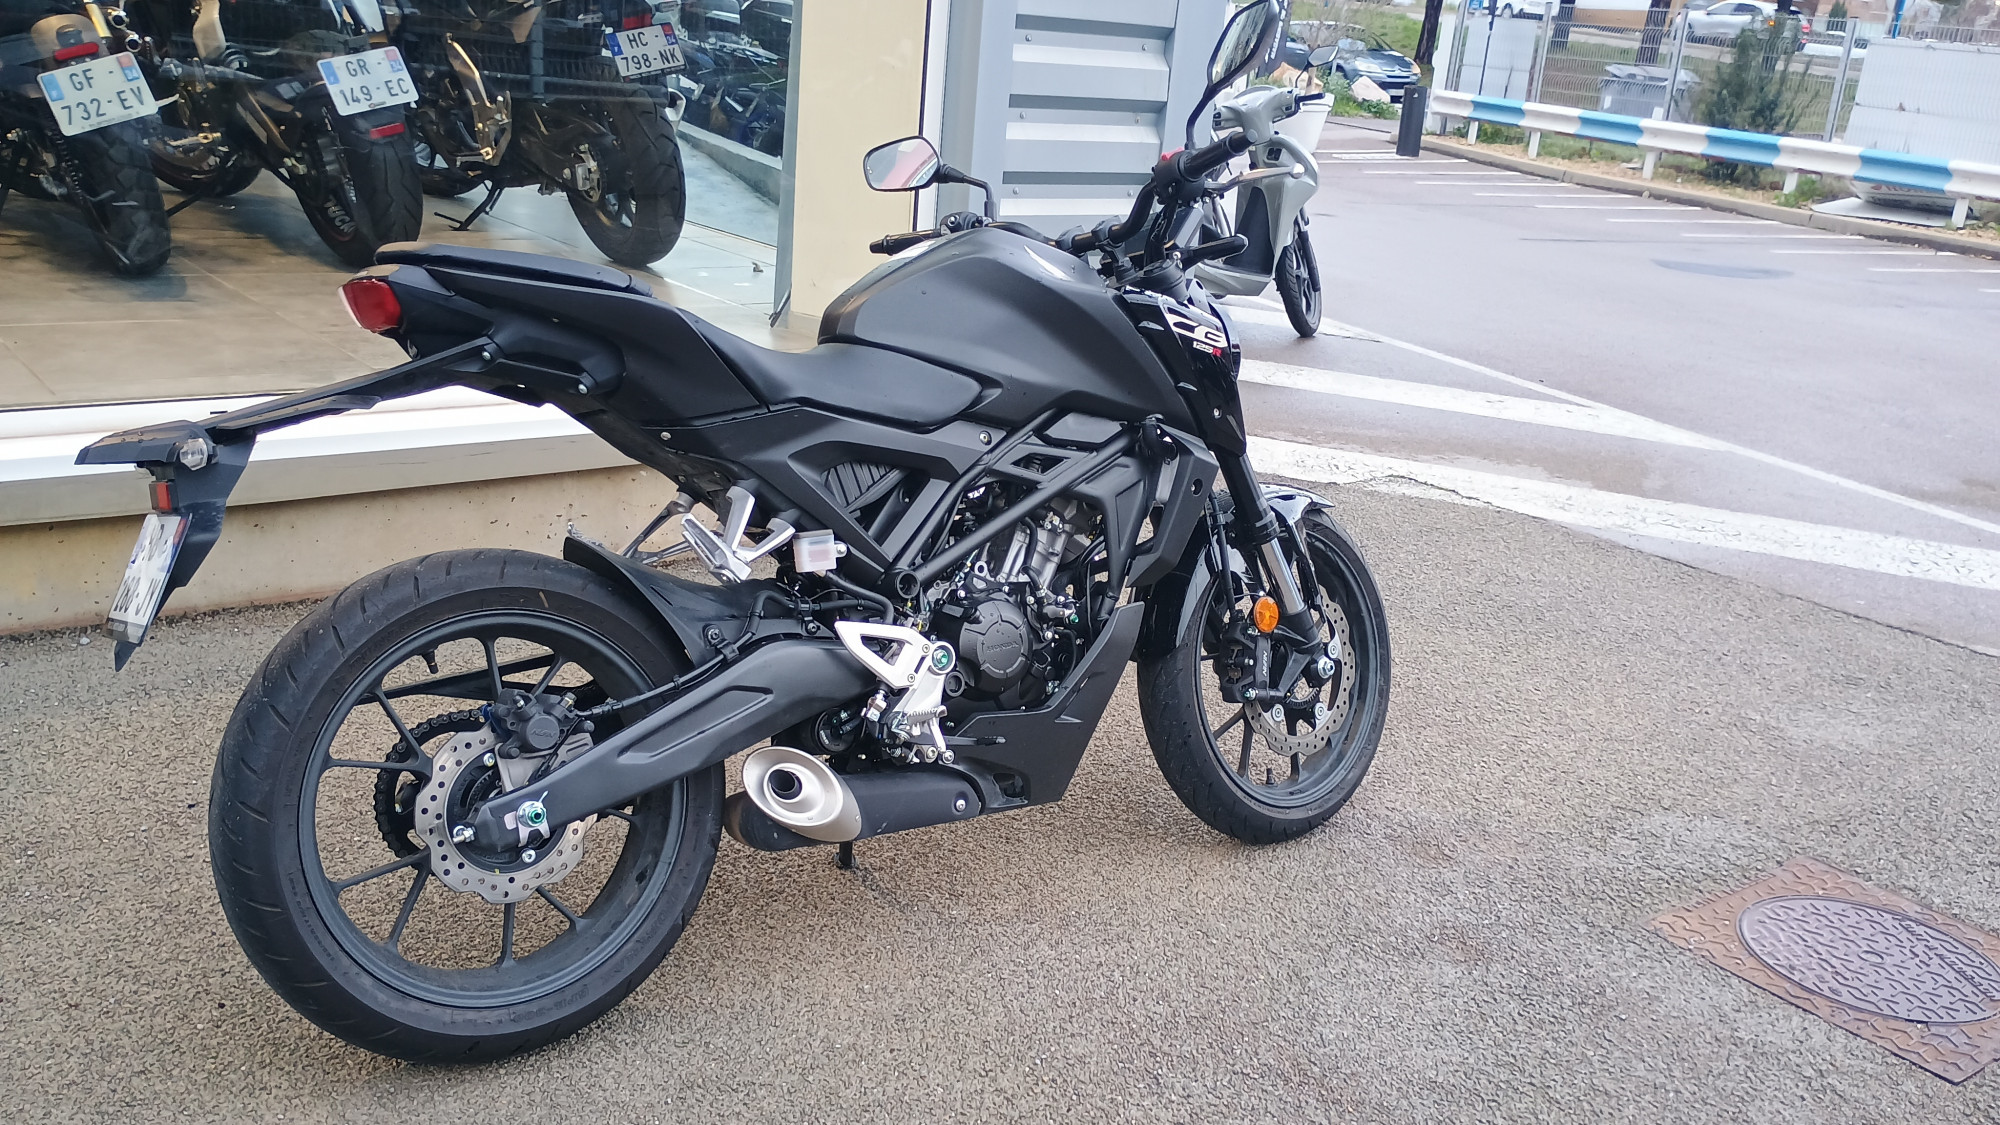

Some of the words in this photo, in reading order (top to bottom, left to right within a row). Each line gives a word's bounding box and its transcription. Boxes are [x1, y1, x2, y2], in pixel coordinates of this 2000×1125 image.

[626, 31, 648, 49] HC
[667, 36, 676, 44] 34
[345, 58, 371, 77] GR
[620, 48, 680, 72] 798-NK
[69, 68, 94, 91] GF
[340, 78, 409, 106] 149-EC
[60, 86, 145, 125] 732-EV
[1164, 312, 1228, 348] CB
[1193, 341, 1222, 357] 125R
